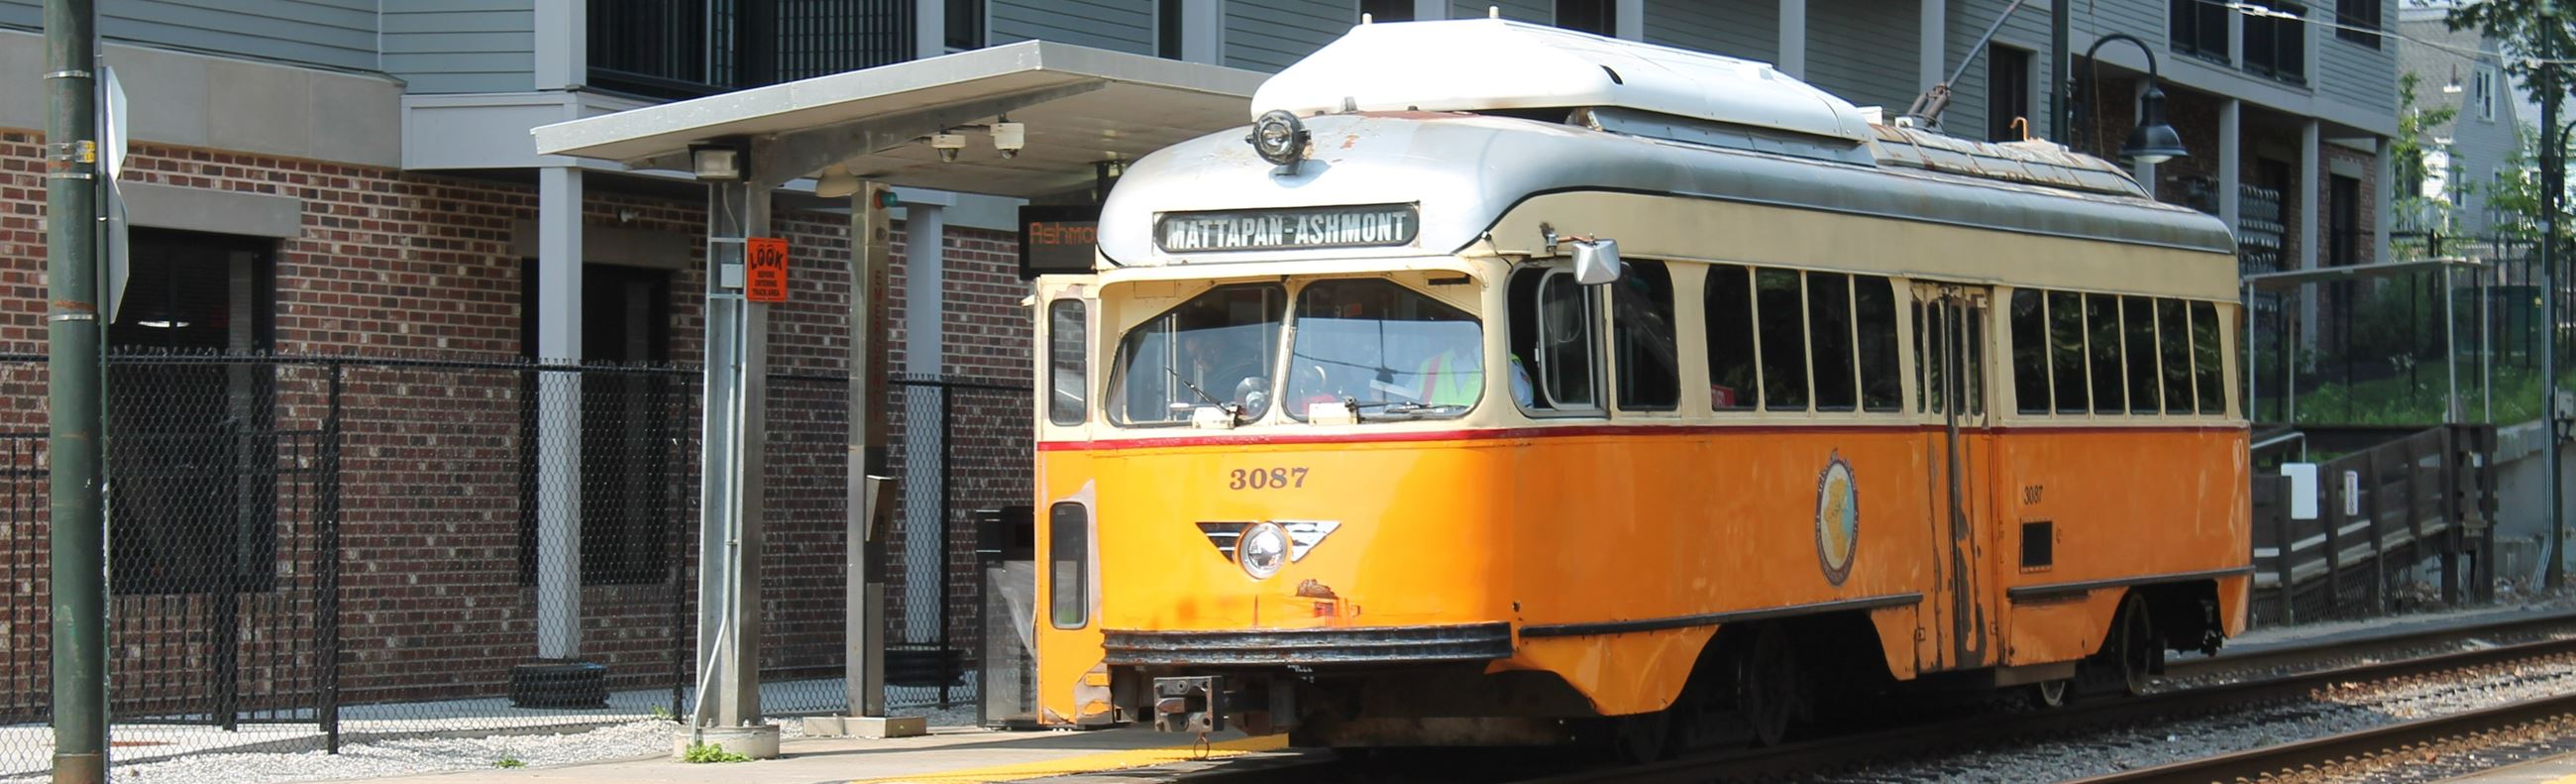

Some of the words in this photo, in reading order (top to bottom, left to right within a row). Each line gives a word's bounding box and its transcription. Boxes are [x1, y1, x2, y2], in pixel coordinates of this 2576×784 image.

[1030, 221, 1096, 245] Ashmo
[1166, 211, 1407, 249] MATTAPAN-ASHMONT
[750, 249, 784, 271] LOOK
[1230, 467, 1310, 491] 3087
[2023, 485, 2044, 504] 3087
